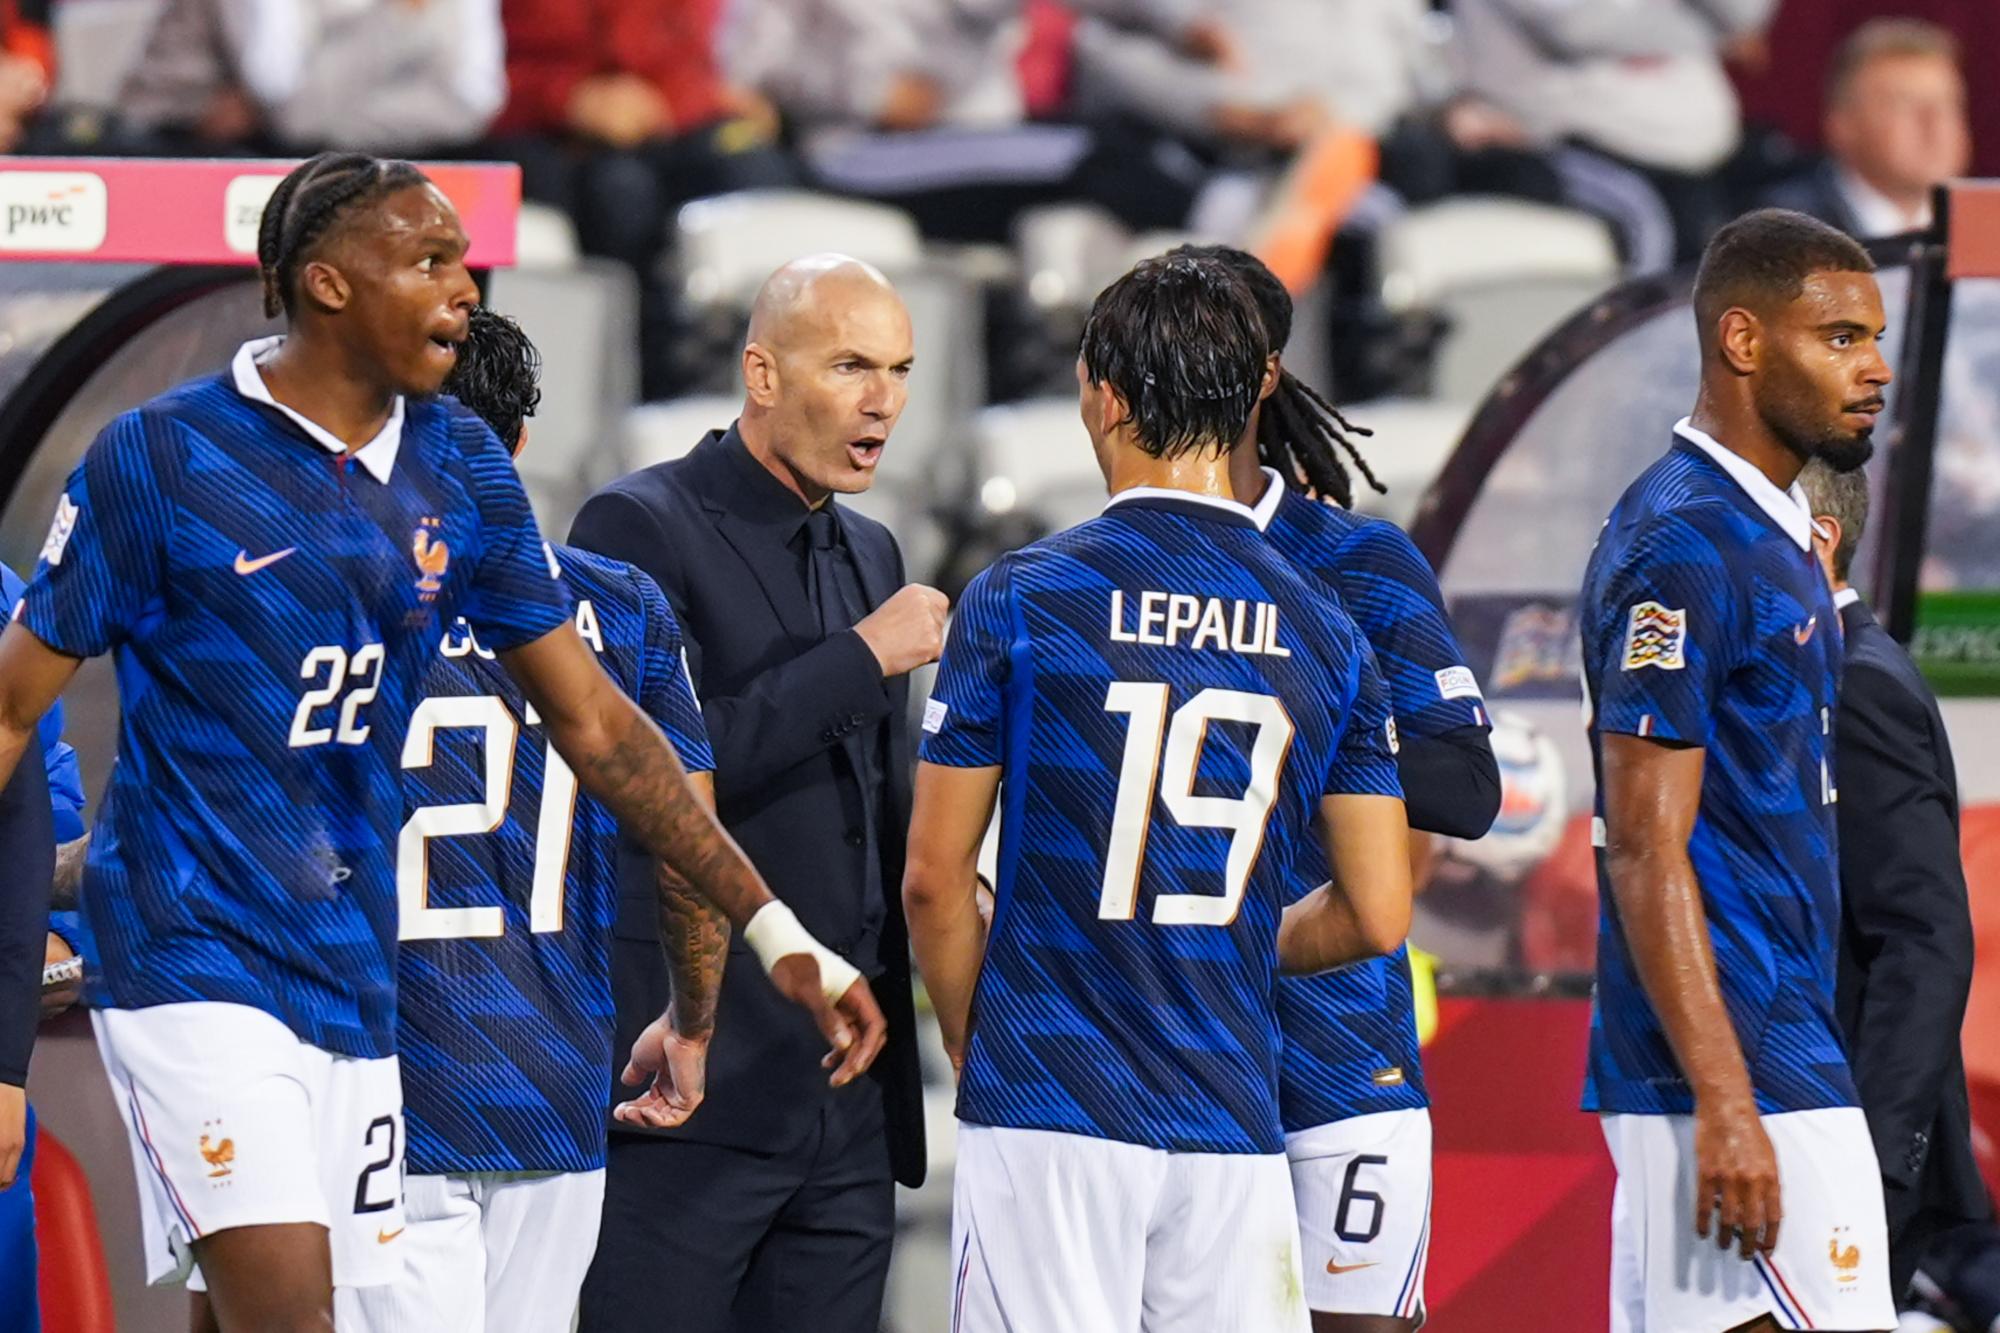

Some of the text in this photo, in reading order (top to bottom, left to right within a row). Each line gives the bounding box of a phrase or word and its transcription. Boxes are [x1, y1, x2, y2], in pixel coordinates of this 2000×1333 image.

[7, 203, 73, 235] pwc
[1109, 589, 1292, 658] LEPAUL
[288, 643, 385, 747] 22
[1098, 681, 1296, 926] 19
[353, 1113, 405, 1214] 2
[1333, 1153, 1388, 1244] 6
